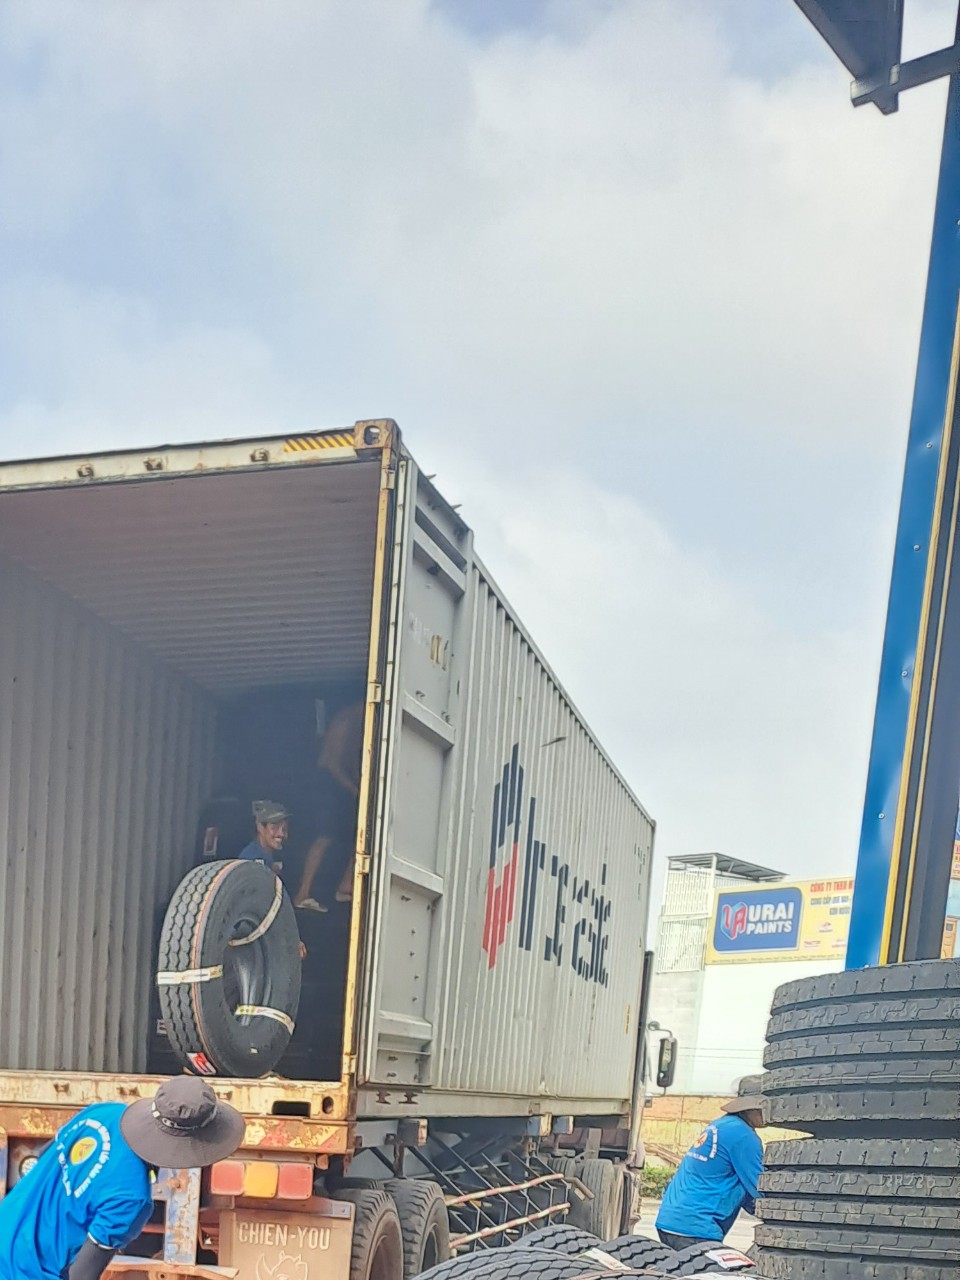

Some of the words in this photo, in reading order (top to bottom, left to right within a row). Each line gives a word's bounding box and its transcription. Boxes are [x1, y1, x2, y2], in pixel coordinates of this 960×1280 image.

[748, 902, 794, 922] URAI
[746, 920, 792, 935] PAINTS
[239, 1222, 330, 1250] CHIEN-YOU
